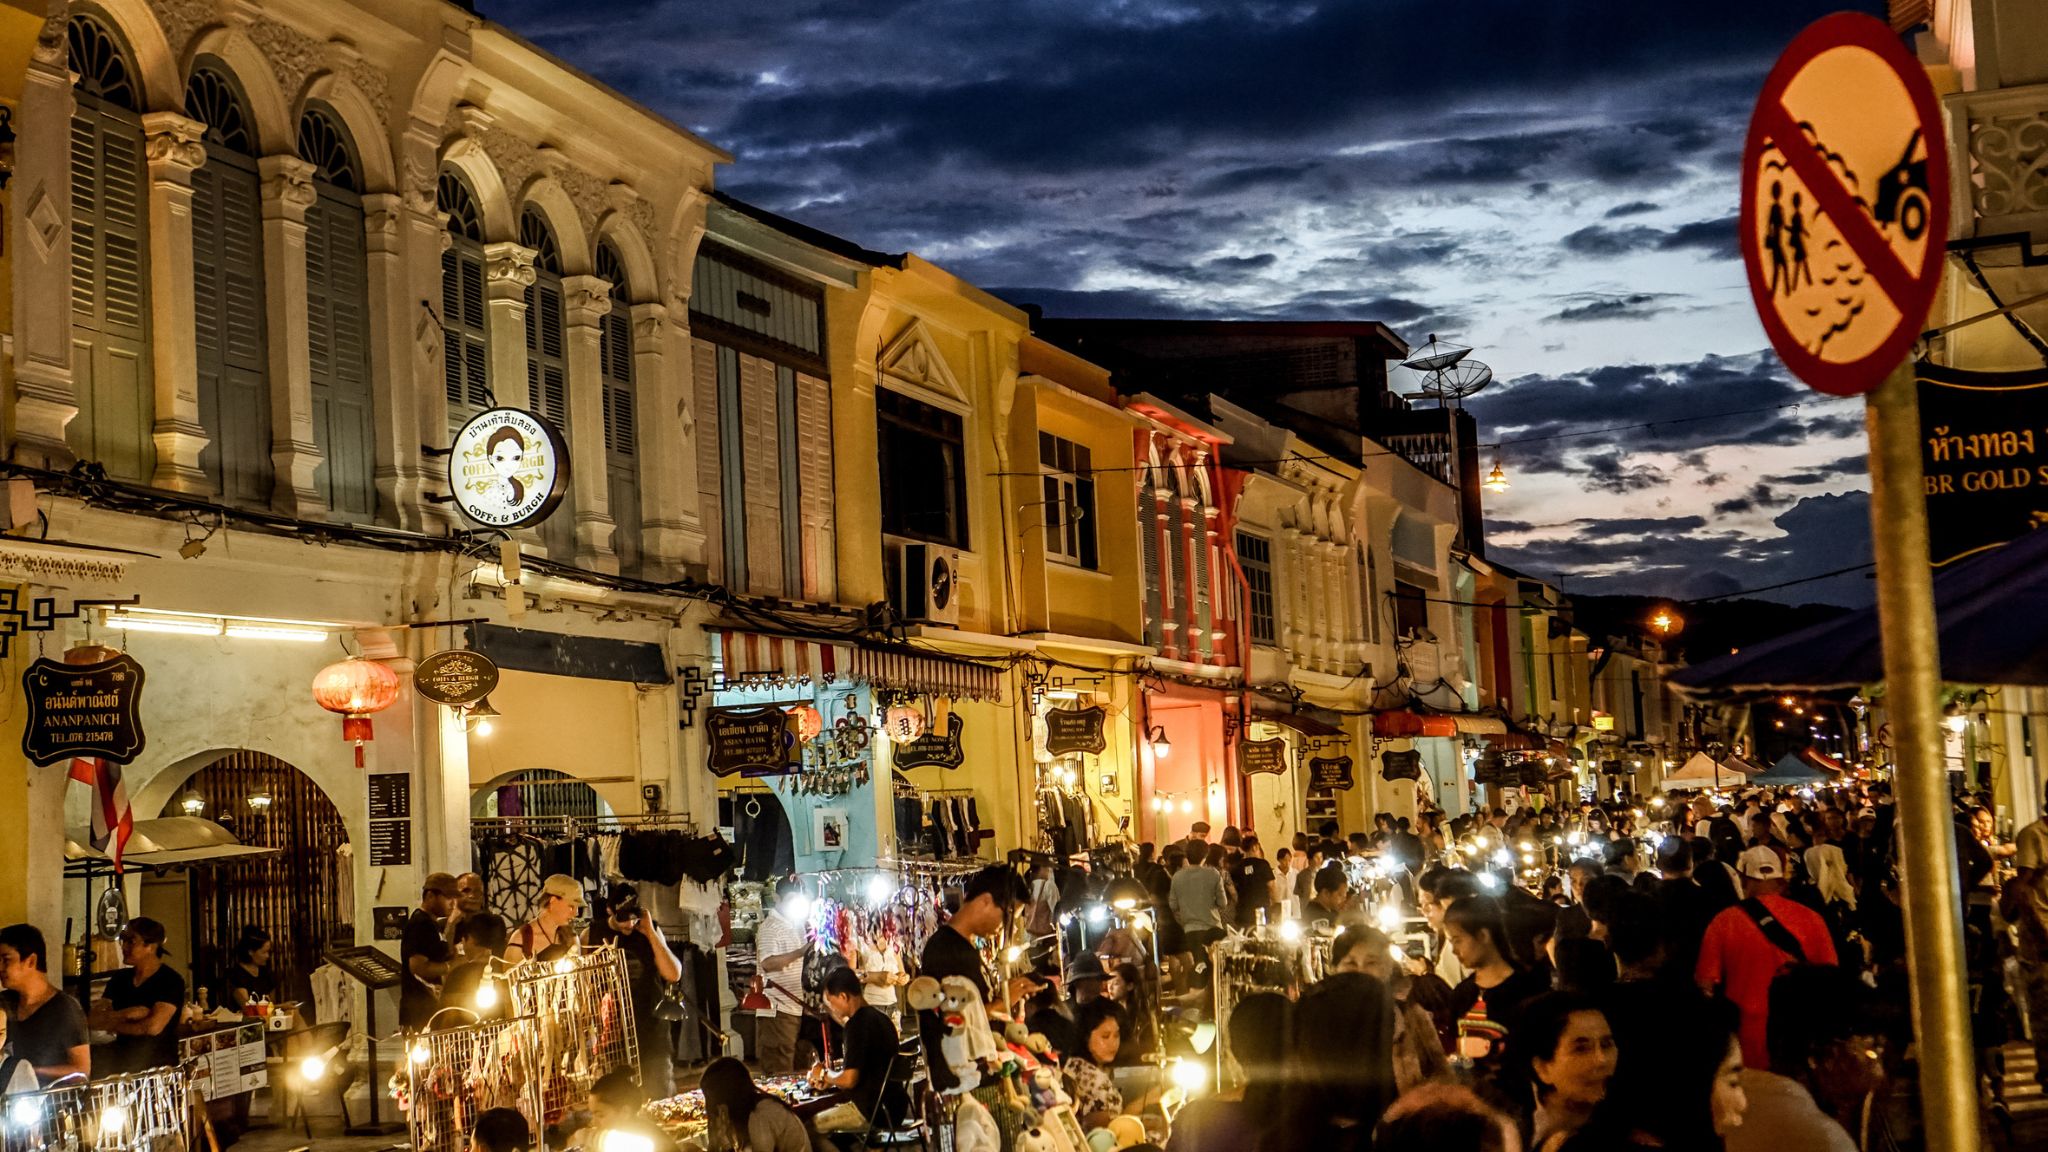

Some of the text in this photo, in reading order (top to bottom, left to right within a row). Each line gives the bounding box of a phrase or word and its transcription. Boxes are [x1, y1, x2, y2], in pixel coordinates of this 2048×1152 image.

[1928, 425, 2035, 462] ห้างทอง
[1961, 468, 2031, 492] GOLD
[501, 514, 509, 523] &
[512, 492, 545, 521] BURGH
[45, 688, 120, 710] อนันต์พาณิชย์
[43, 713, 120, 727] ANANPANICH
